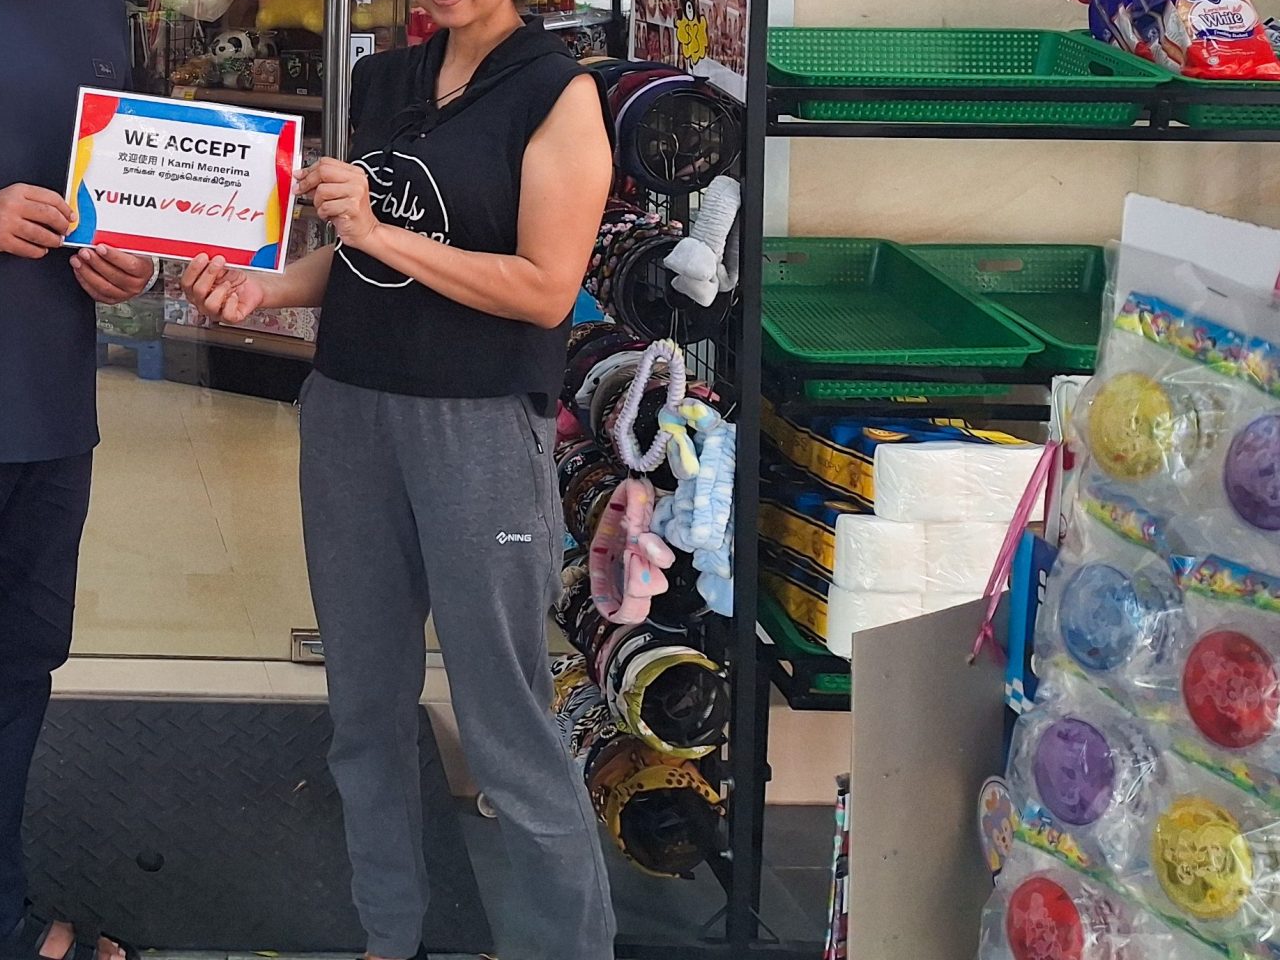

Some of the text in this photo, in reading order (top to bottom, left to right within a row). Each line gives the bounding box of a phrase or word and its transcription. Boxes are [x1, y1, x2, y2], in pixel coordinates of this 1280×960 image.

[1198, 11, 1244, 28] White
[124, 129, 252, 161] WE ACCEPT
[117, 151, 158, 166] 欢迎使用
[167, 158, 251, 178] Kami Menerima
[94, 189, 158, 210] YUHUA
